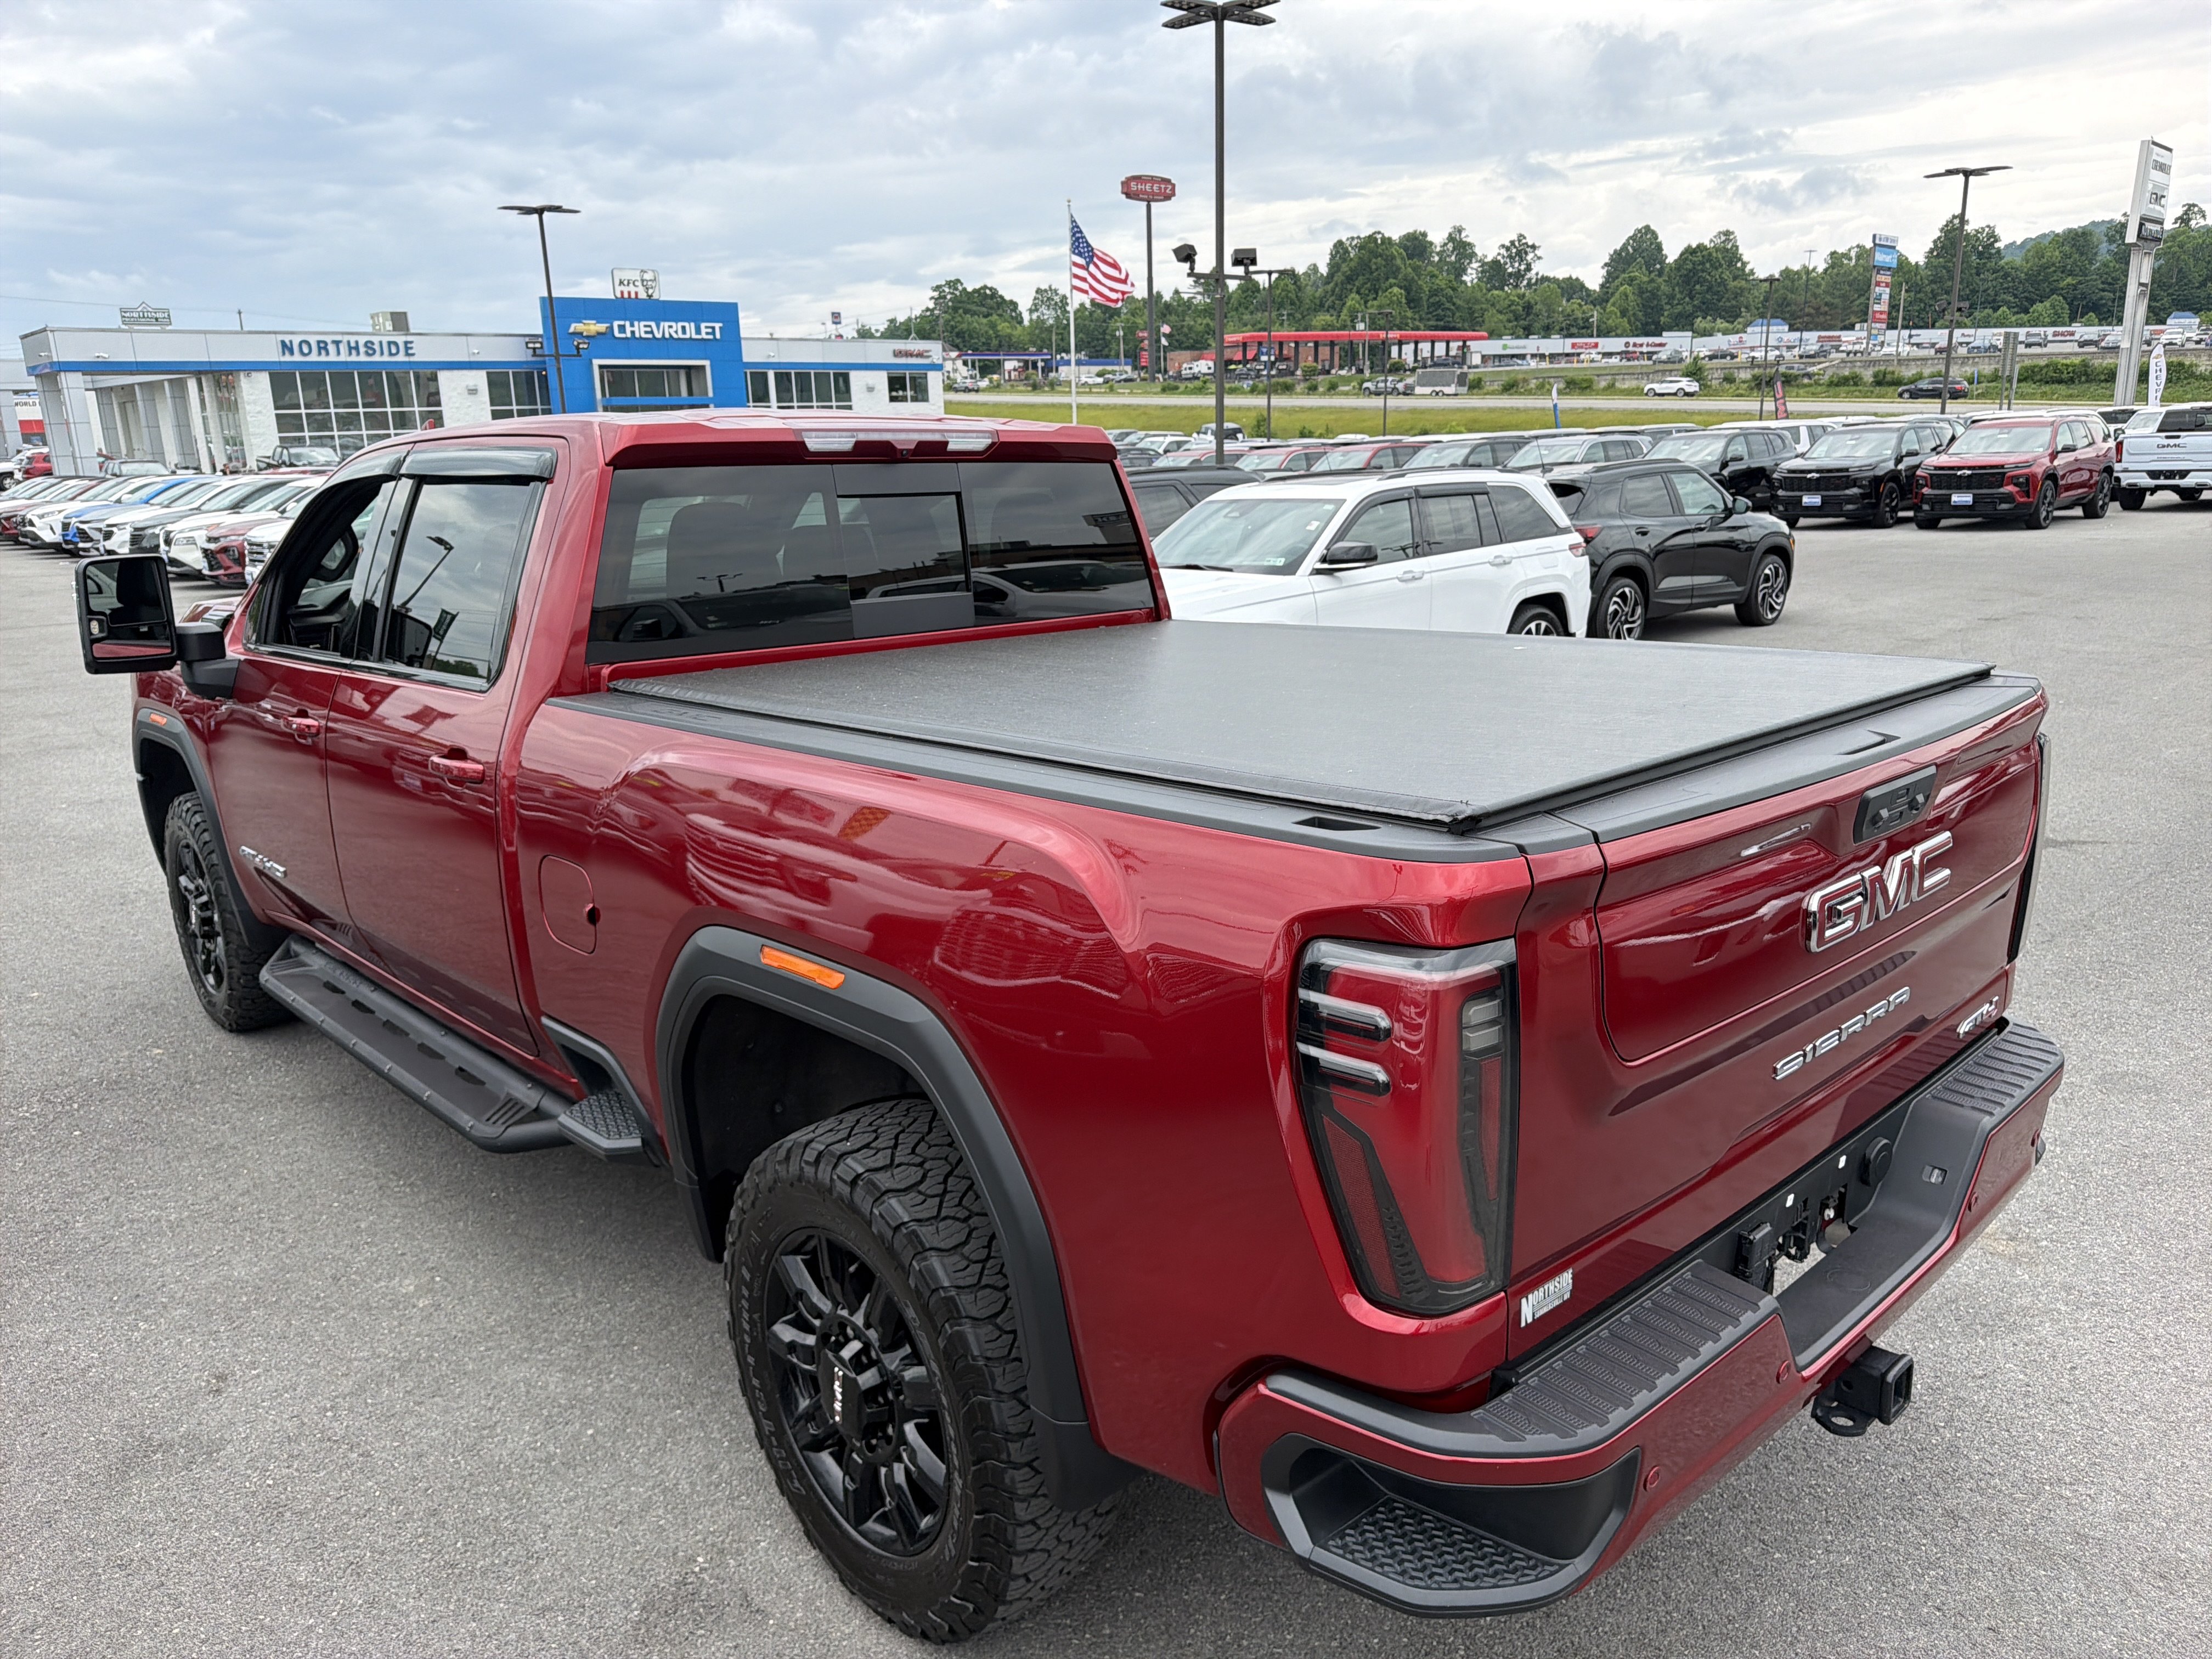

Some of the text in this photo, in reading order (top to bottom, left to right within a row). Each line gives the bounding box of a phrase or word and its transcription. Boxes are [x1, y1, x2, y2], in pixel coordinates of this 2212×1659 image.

[1130, 182, 1172, 194] SHEETZ
[618, 278, 639, 287] KFC
[612, 320, 723, 340] CHEVROLET
[280, 339, 416, 357] NORTHSIDE
[1802, 830, 1953, 953] GMC
[1956, 996, 1999, 1039] AT4
[1770, 986, 1911, 1081] SIERRA
[1520, 1267, 1573, 1328] NORTHSIDE
